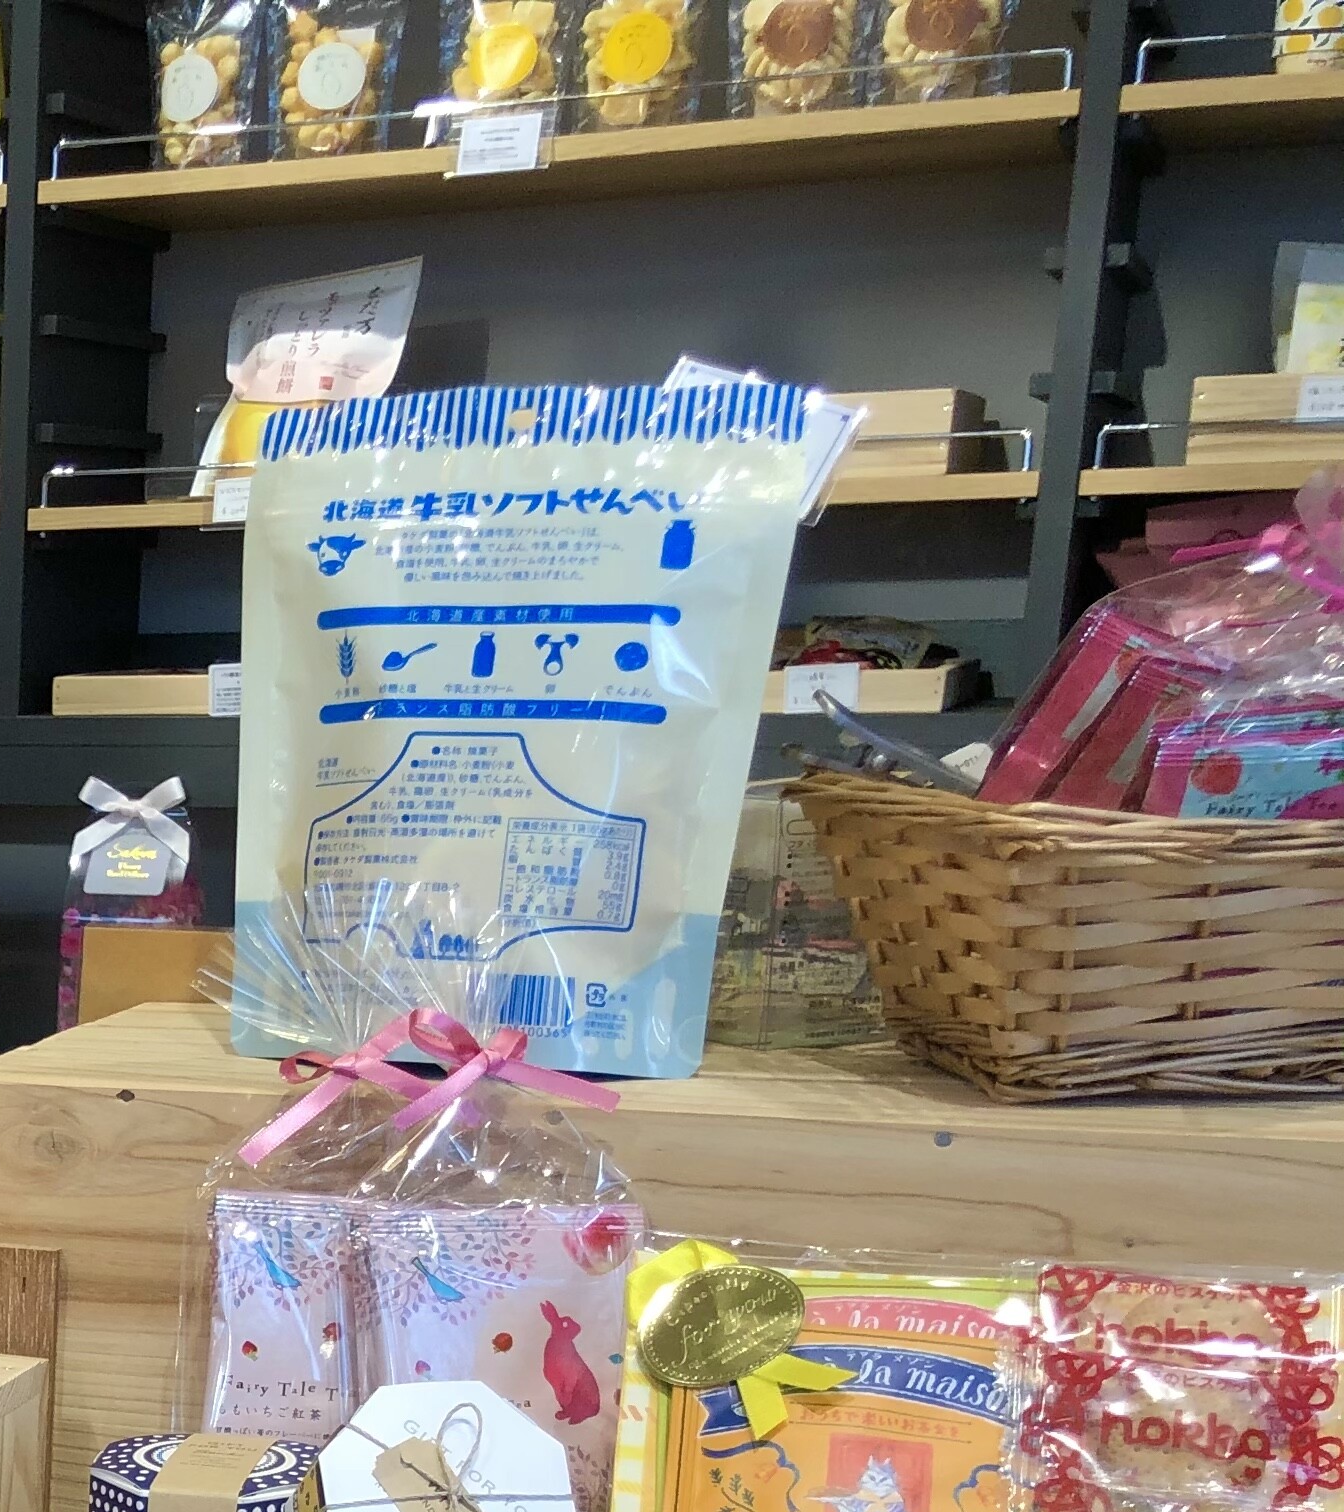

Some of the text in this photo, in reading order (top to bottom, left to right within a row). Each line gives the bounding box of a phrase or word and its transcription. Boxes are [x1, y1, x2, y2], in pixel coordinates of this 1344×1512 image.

[410, 487, 687, 522] 牛乳ソフトせんべい
[603, 684, 654, 699] でんぷん
[277, 1379, 317, 1398] Tale
